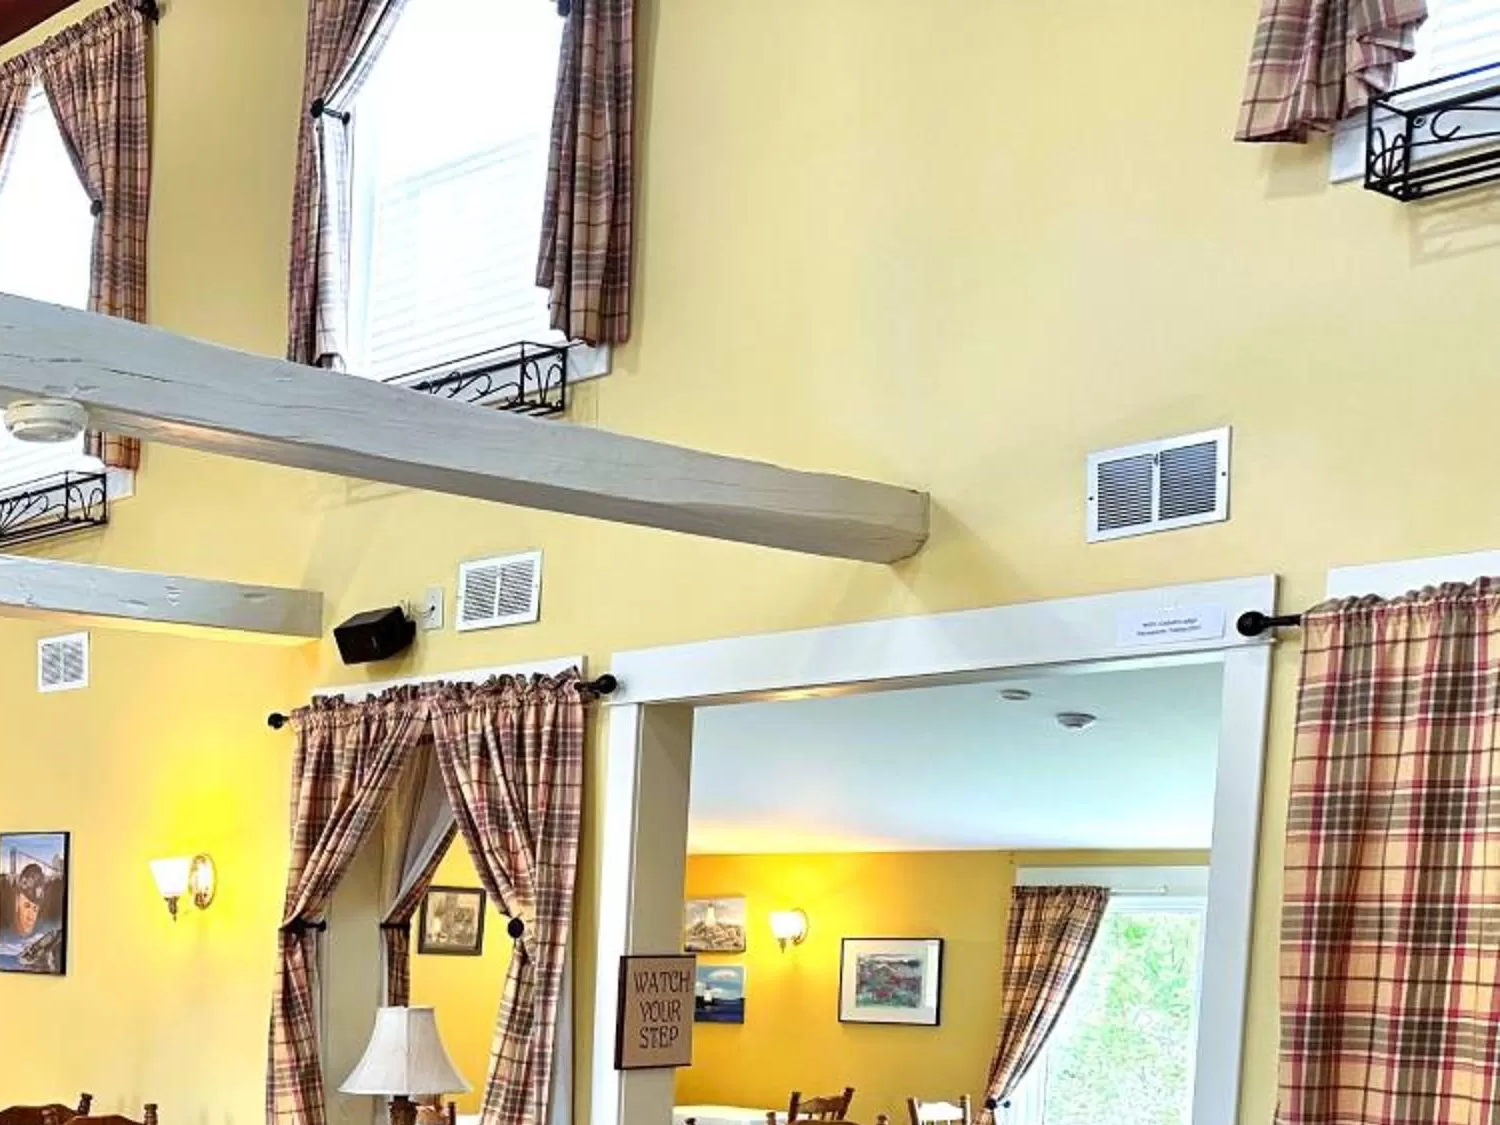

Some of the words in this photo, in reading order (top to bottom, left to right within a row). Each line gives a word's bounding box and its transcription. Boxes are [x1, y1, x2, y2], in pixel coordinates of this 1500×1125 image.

[634, 971, 691, 993] WATCH
[640, 1000, 681, 1022] YOUR
[639, 1025, 679, 1048] STEP
